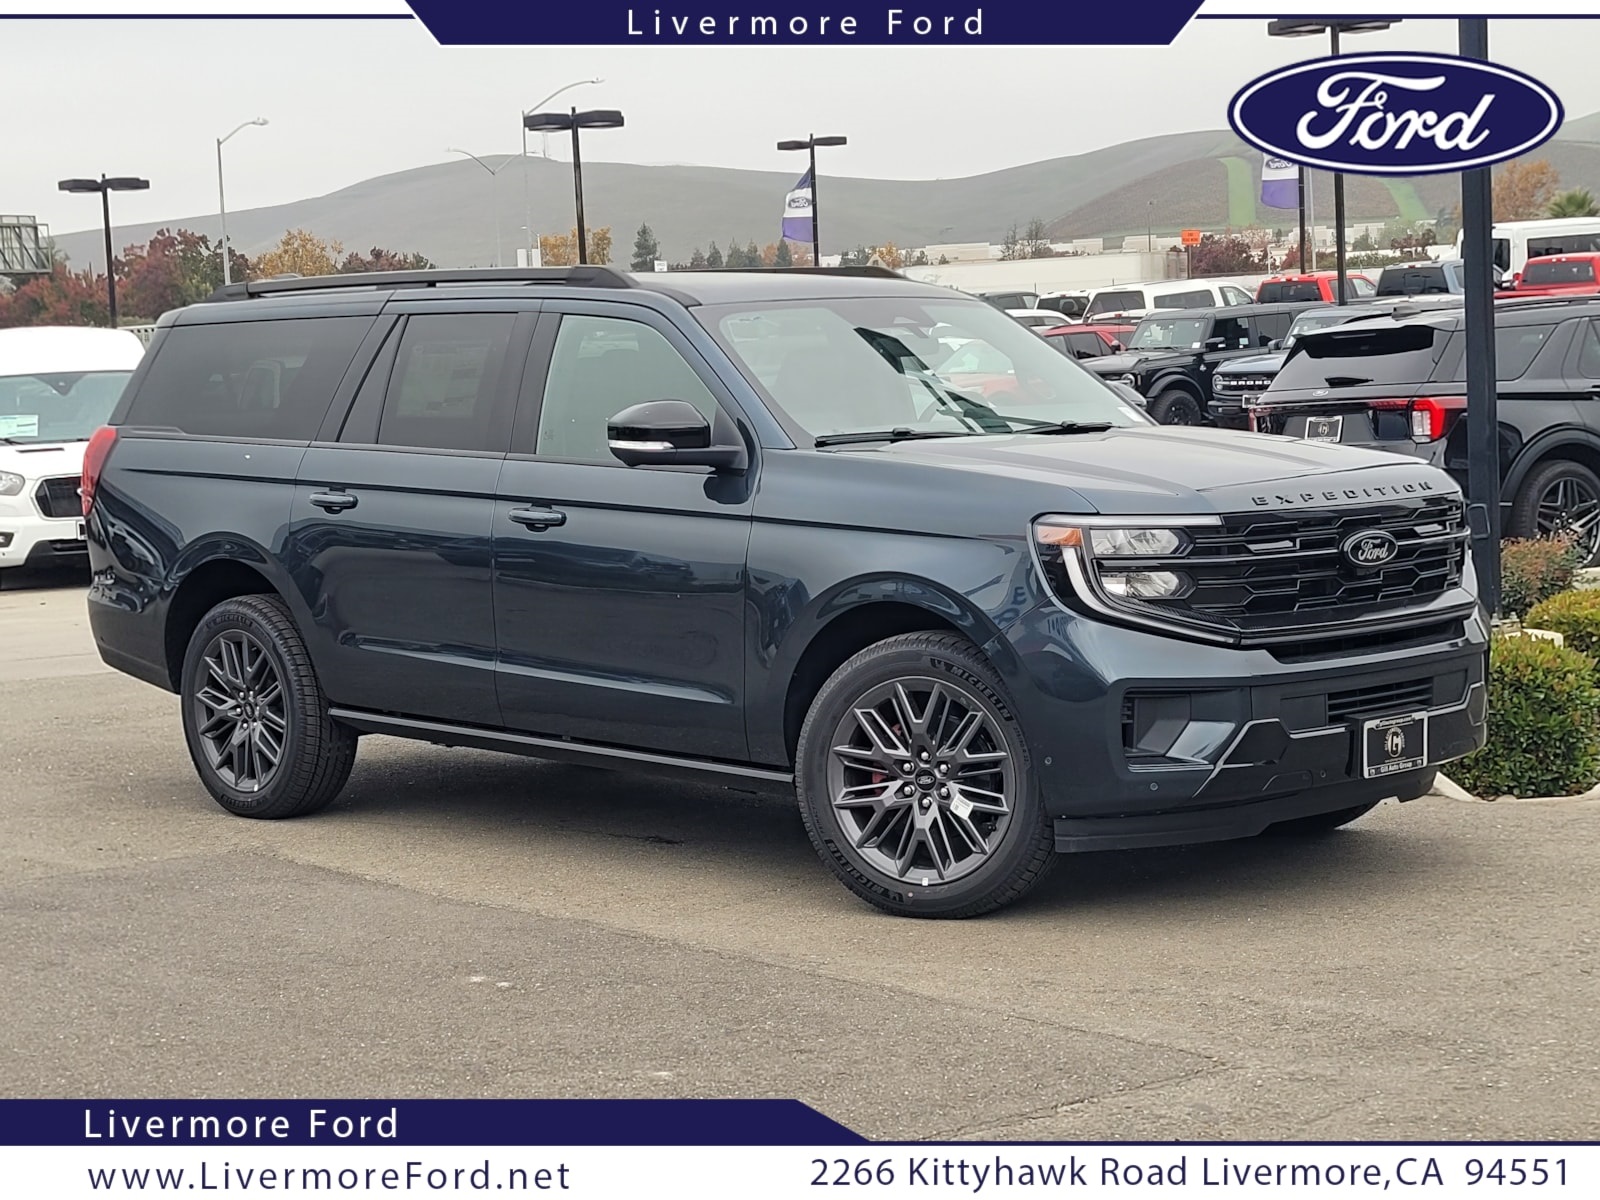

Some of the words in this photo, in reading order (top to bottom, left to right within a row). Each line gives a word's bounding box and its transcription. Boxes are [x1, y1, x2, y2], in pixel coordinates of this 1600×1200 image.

[1252, 481, 1434, 506] EXPEDITION
[1358, 538, 1389, 561] Ford
[950, 666, 1012, 720] MICHELIN
[1389, 763, 1399, 771] Auto
[1400, 761, 1413, 769] Group
[826, 841, 887, 894] MICHELIN
